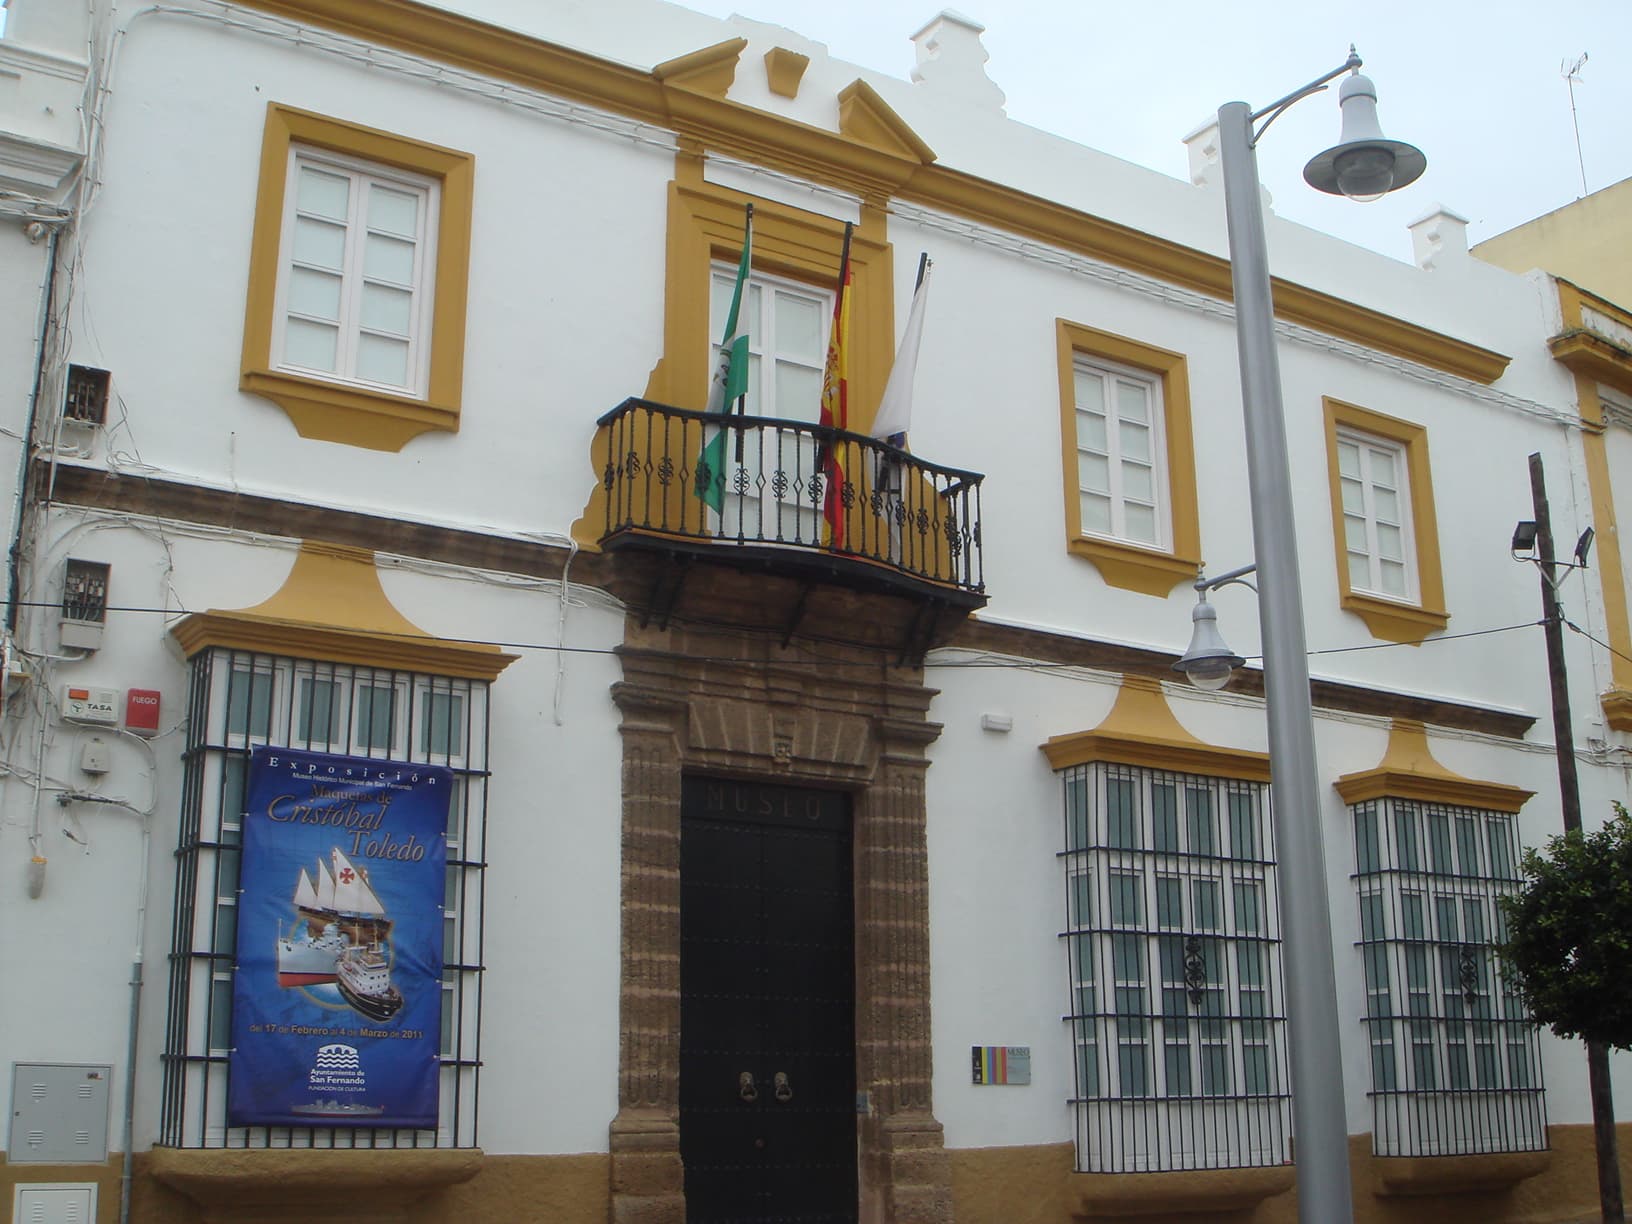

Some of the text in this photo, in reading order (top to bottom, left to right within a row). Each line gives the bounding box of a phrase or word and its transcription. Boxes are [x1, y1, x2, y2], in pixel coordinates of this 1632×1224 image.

[87, 703, 112, 712] TASA
[132, 696, 158, 705] FUEGO
[269, 756, 436, 785] Exposición
[311, 784, 372, 803] Maquetas
[267, 794, 388, 831] Cristóbal
[348, 829, 425, 863] Toledo
[265, 1024, 276, 1033] 17
[291, 1024, 328, 1036] Febrero
[340, 1027, 346, 1036] 4
[360, 1027, 388, 1038] Marzo
[402, 1029, 423, 1039] 2011
[310, 1068, 356, 1077] Ayuntamiento
[310, 1075, 365, 1085] San Fernando
